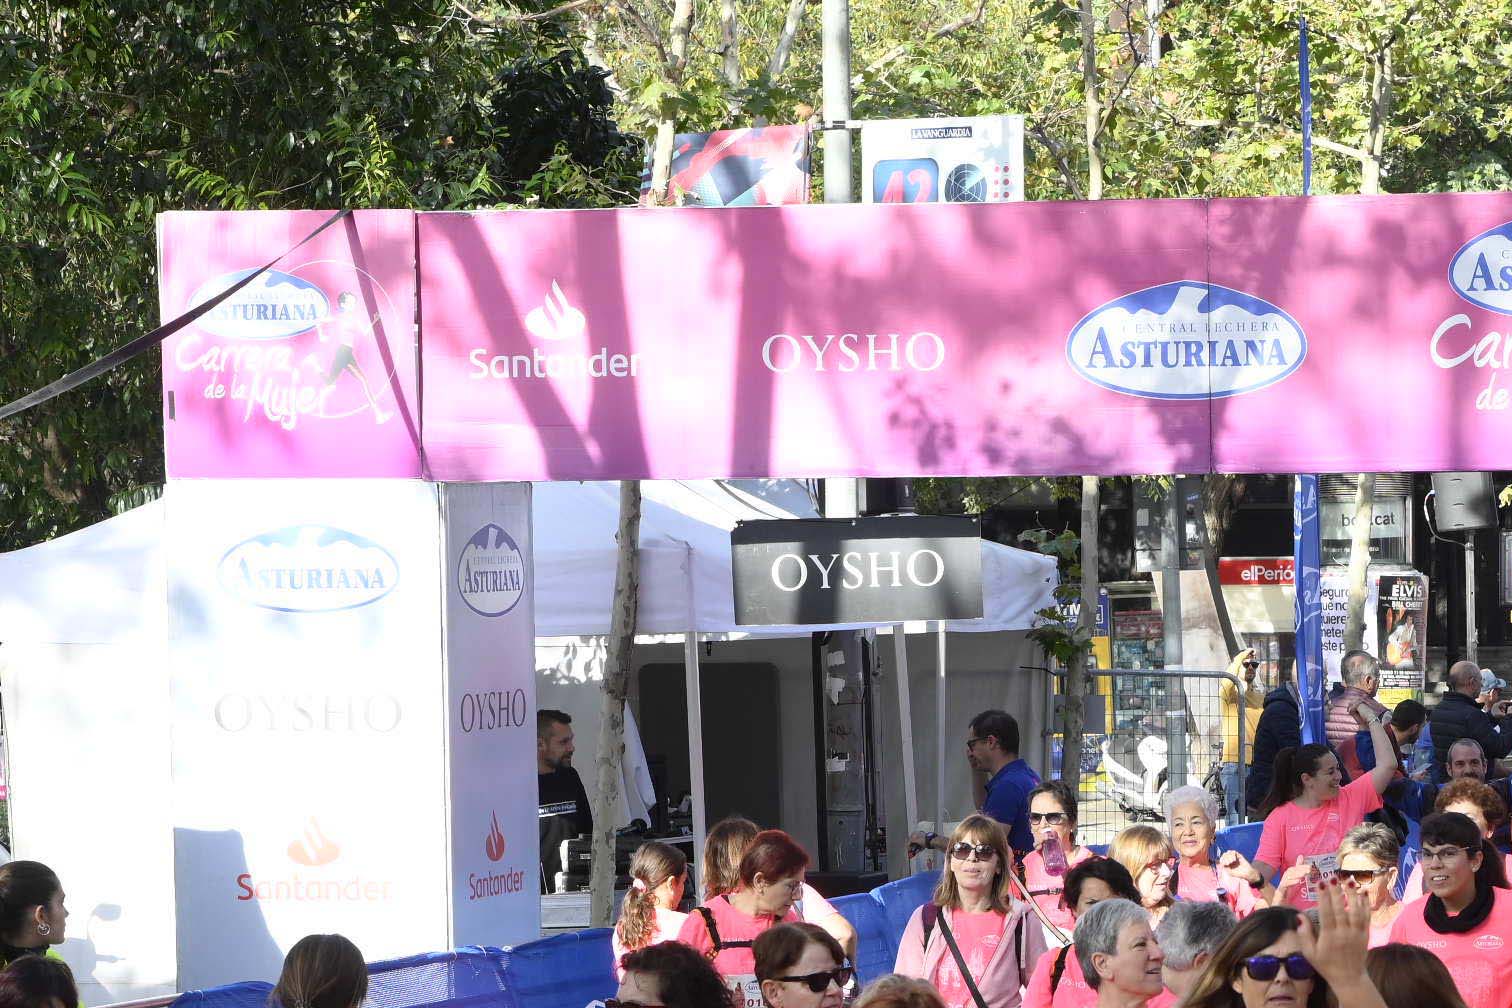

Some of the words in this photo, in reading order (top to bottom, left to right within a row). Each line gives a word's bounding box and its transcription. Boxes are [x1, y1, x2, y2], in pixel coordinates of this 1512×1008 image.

[175, 334, 294, 372] Carrera
[468, 347, 643, 378] Santander
[761, 331, 945, 373] OYSHO
[1085, 326, 1289, 369] ASTURIANA
[203, 375, 226, 399] de
[243, 368, 337, 430] Mujer
[1475, 373, 1509, 411] de
[237, 557, 386, 591] ASTURIANA
[463, 562, 520, 594] ASTURIANA
[771, 549, 945, 591] OYSHO
[1240, 565, 1295, 582] elPerió
[1392, 584, 1423, 597] ELVIS
[214, 691, 401, 734] OYSHO
[460, 688, 526, 733] OYSHO
[237, 873, 390, 901] Santander
[469, 868, 525, 901] Santander
